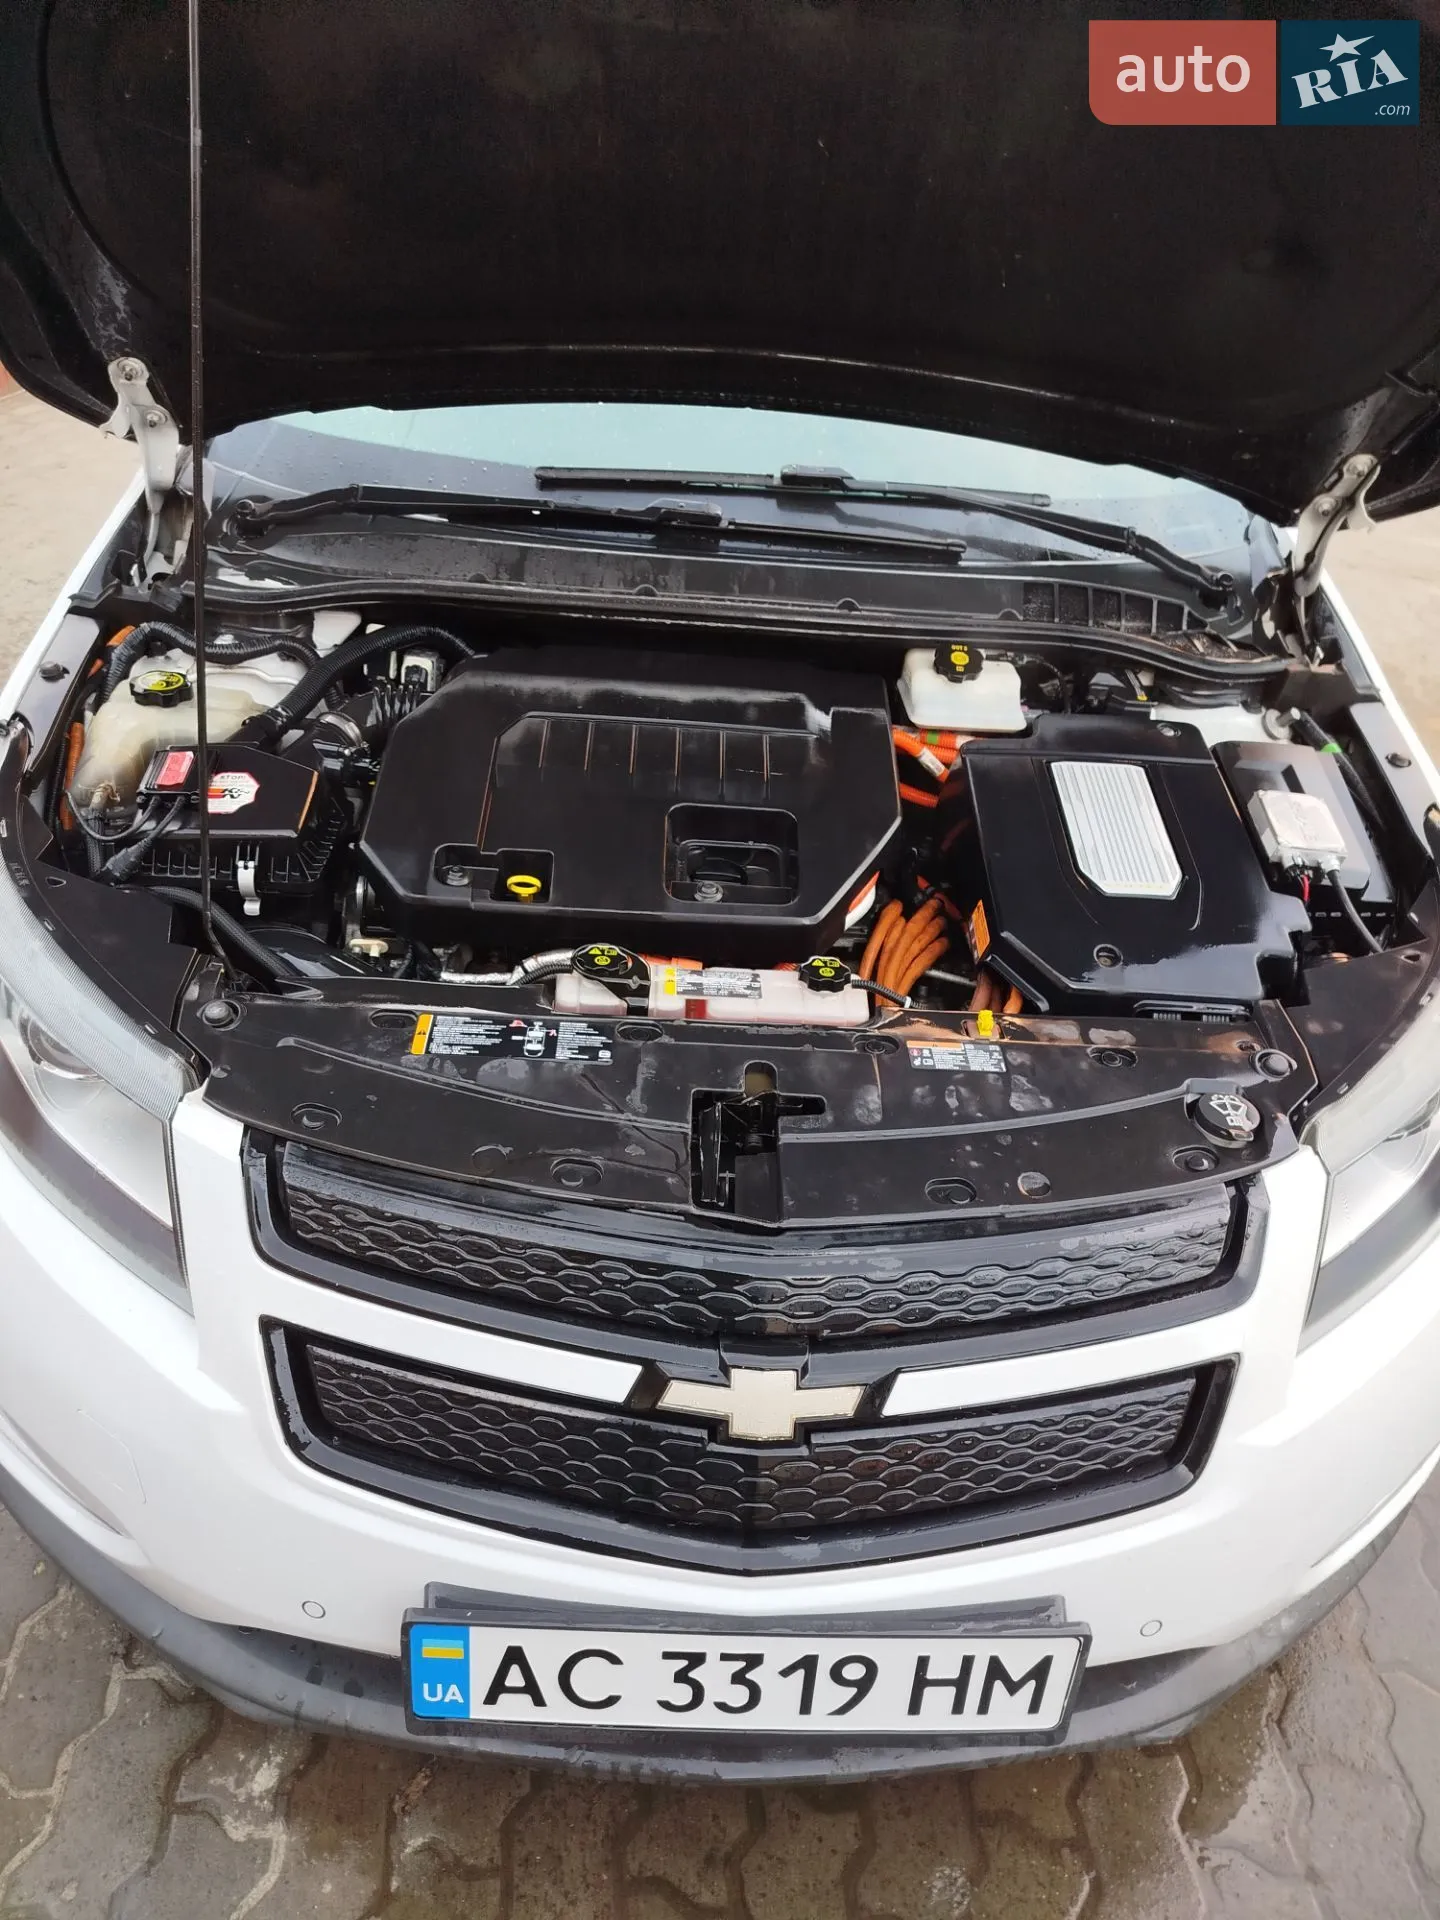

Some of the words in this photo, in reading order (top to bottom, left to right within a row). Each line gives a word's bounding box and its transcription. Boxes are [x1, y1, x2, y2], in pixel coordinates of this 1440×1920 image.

[423, 1683, 465, 1703] UA
[482, 1645, 624, 1710] AC
[656, 1651, 879, 1716] 3319
[907, 1654, 1054, 1716] HM
